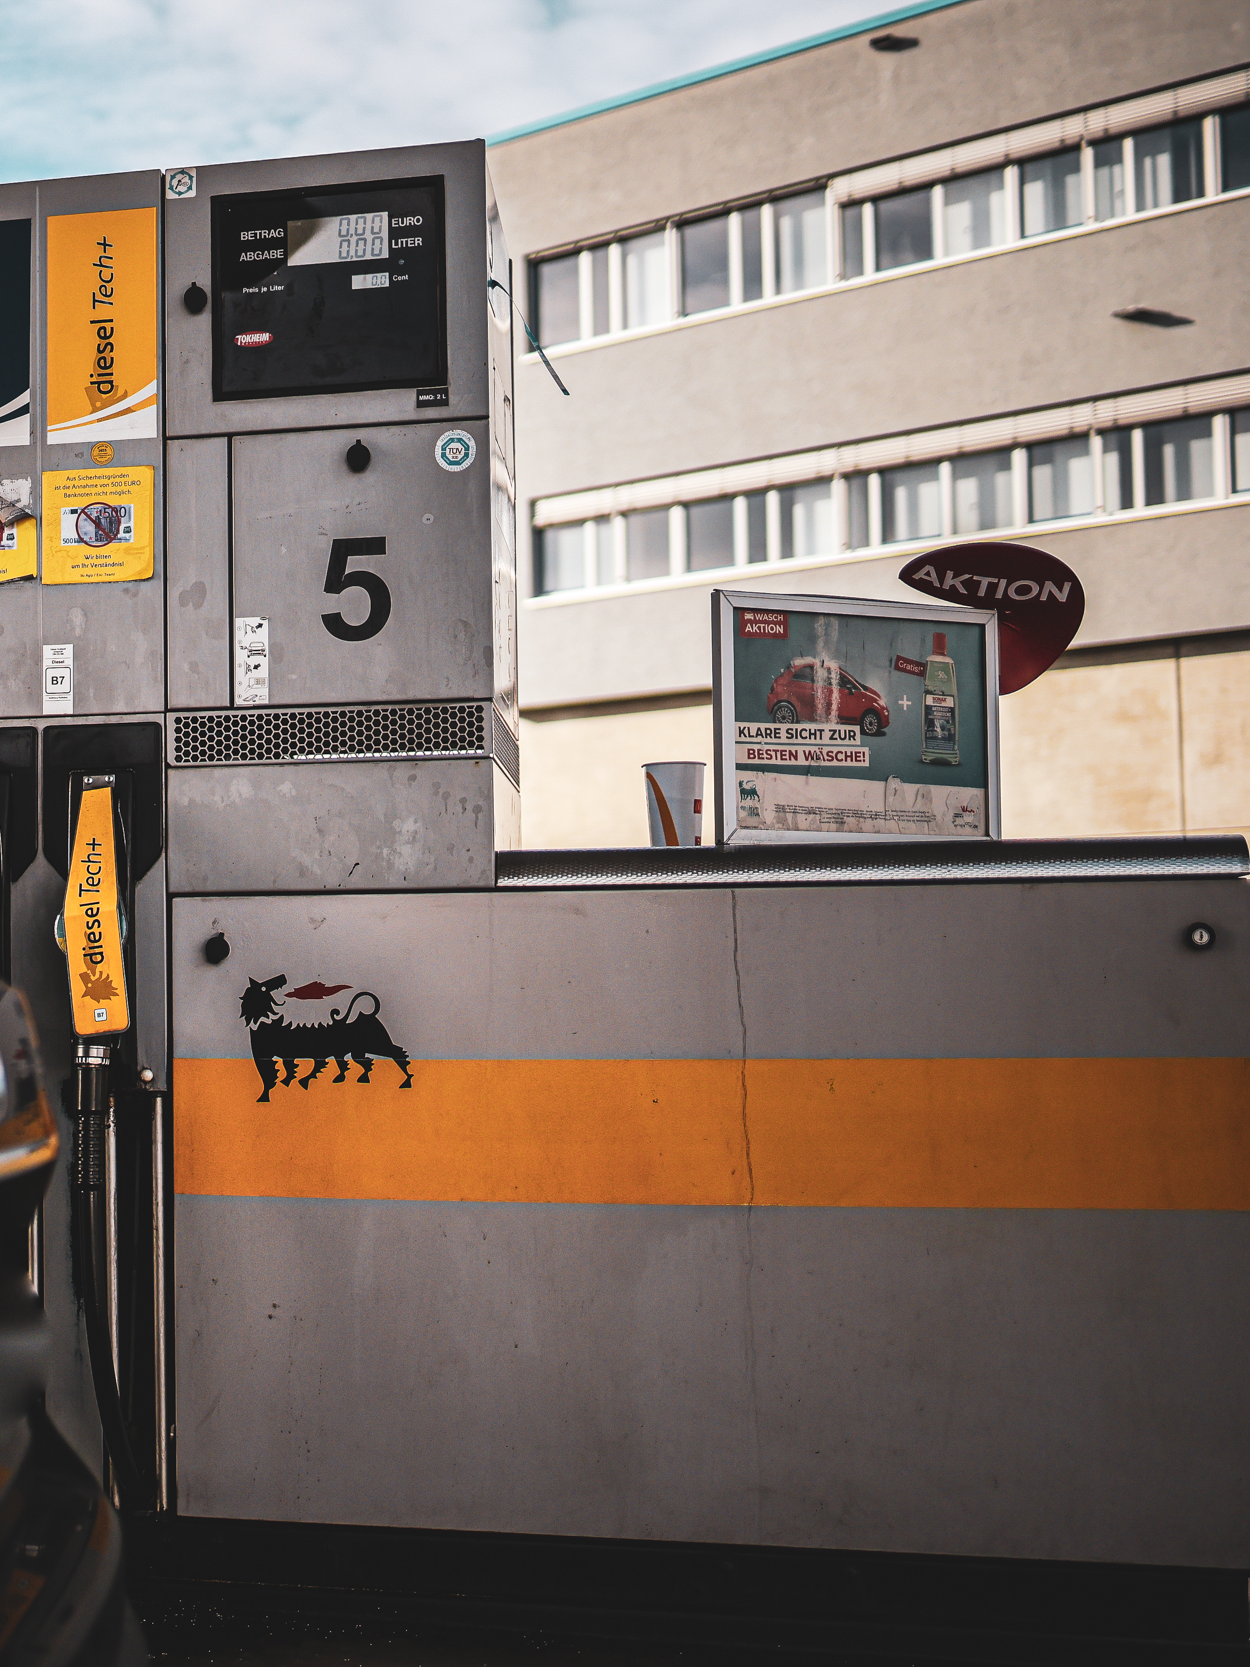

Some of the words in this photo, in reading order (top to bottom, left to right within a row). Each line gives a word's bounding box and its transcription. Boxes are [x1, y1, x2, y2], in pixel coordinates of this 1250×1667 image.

[338, 214, 383, 238] 0,00
[392, 216, 423, 227] EURO
[240, 228, 284, 241] BETRAG
[338, 236, 384, 260] 0,00
[392, 238, 423, 249] LITER
[240, 250, 284, 262] ABGABE
[92, 236, 114, 310] Tech+
[235, 332, 270, 346] TOKHEIM
[90, 318, 114, 395] diesel
[448, 447, 463, 455] TÜV
[78, 473, 130, 482] Sicherheitsgründen
[109, 489, 132, 497] möglich.
[103, 506, 127, 519] 500
[320, 536, 392, 642] 5
[912, 564, 1072, 603] AKTION
[755, 613, 784, 622] WASCH
[745, 624, 784, 634] AKTION
[51, 676, 65, 686] B7
[738, 726, 782, 739] KLARE
[786, 728, 825, 741] SICHT
[829, 730, 857, 741] ZUR
[747, 749, 798, 762] BESTEN
[804, 748, 866, 763] WÄSCHE!
[79, 838, 103, 898] Tech+
[79, 902, 105, 965] diesel
